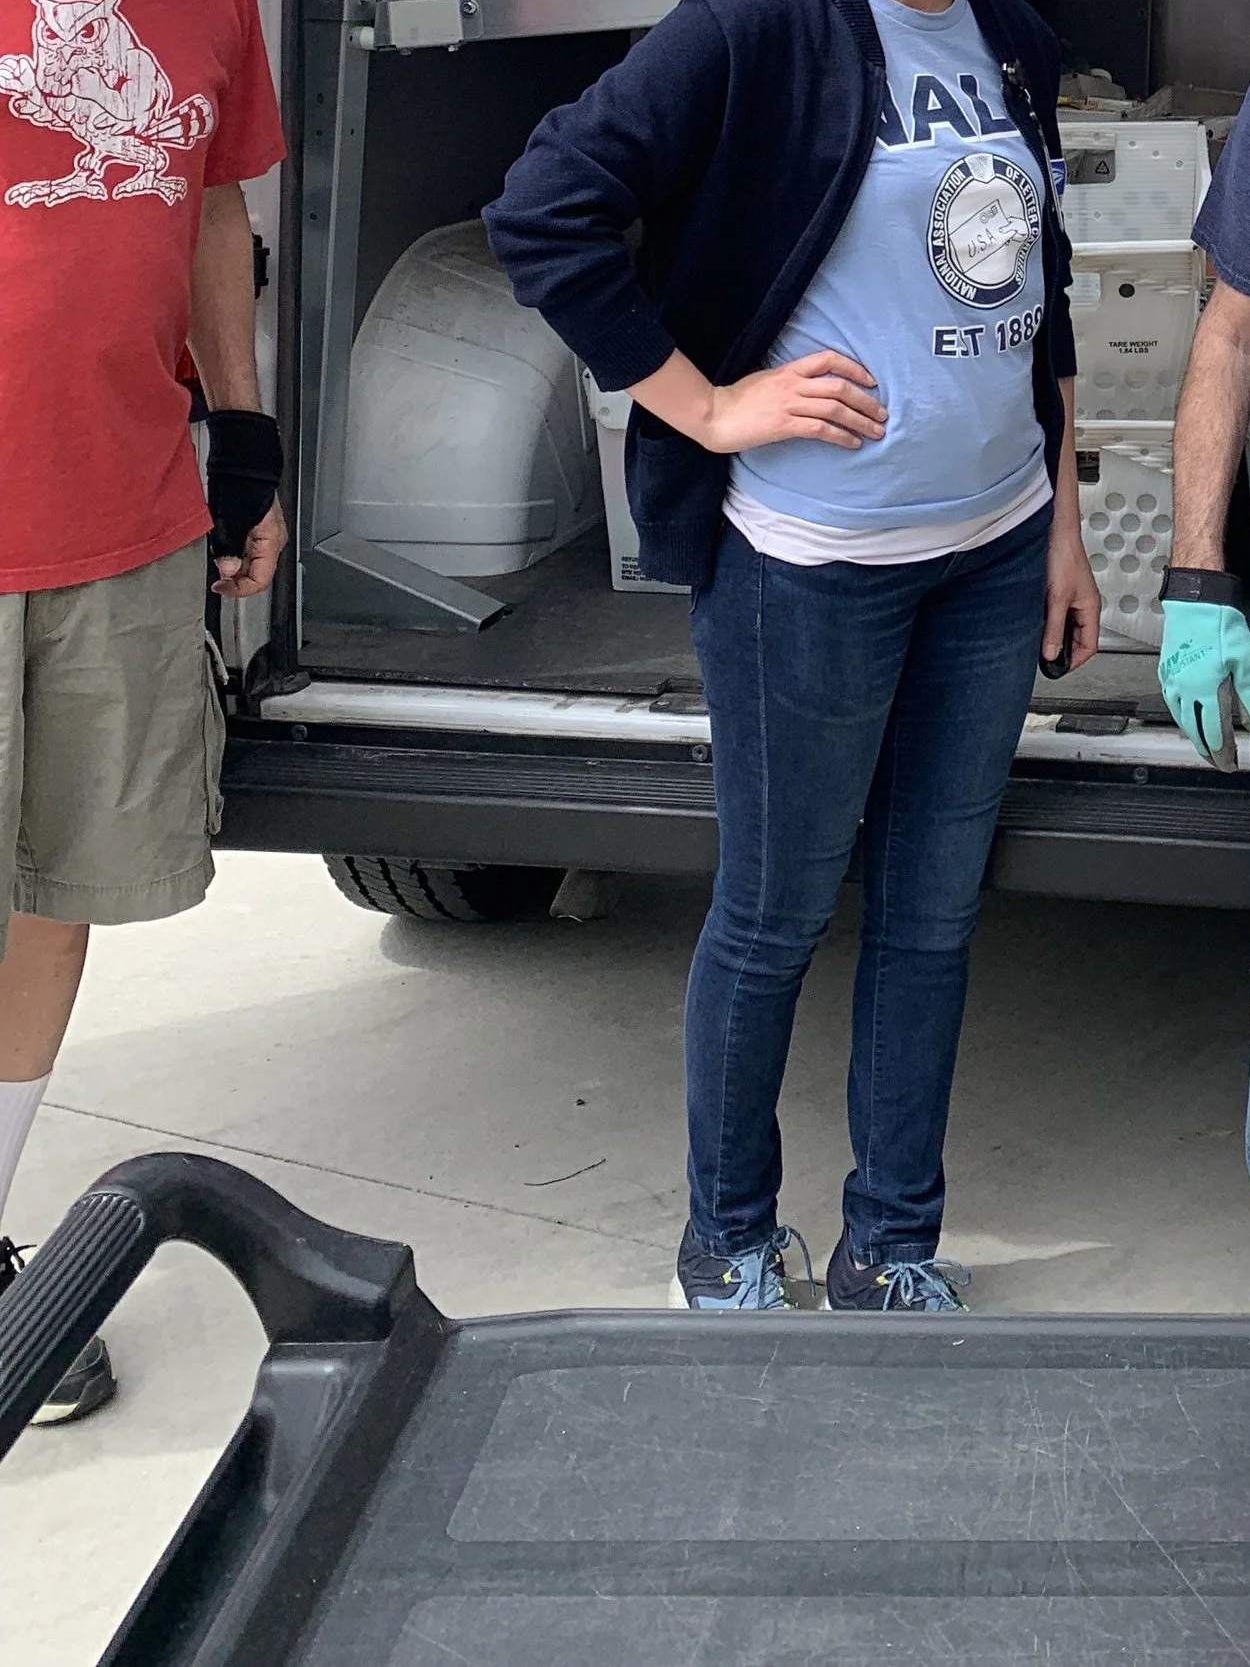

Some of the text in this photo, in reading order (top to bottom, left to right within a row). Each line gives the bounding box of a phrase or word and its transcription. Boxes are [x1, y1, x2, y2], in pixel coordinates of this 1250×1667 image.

[1005, 166, 1021, 181] OF
[933, 168, 966, 247] ASSOCIATION
[1019, 179, 1039, 224] LETTER
[933, 249, 977, 300] NATIONAL
[1108, 340, 1158, 348] TARE WEIGHT
